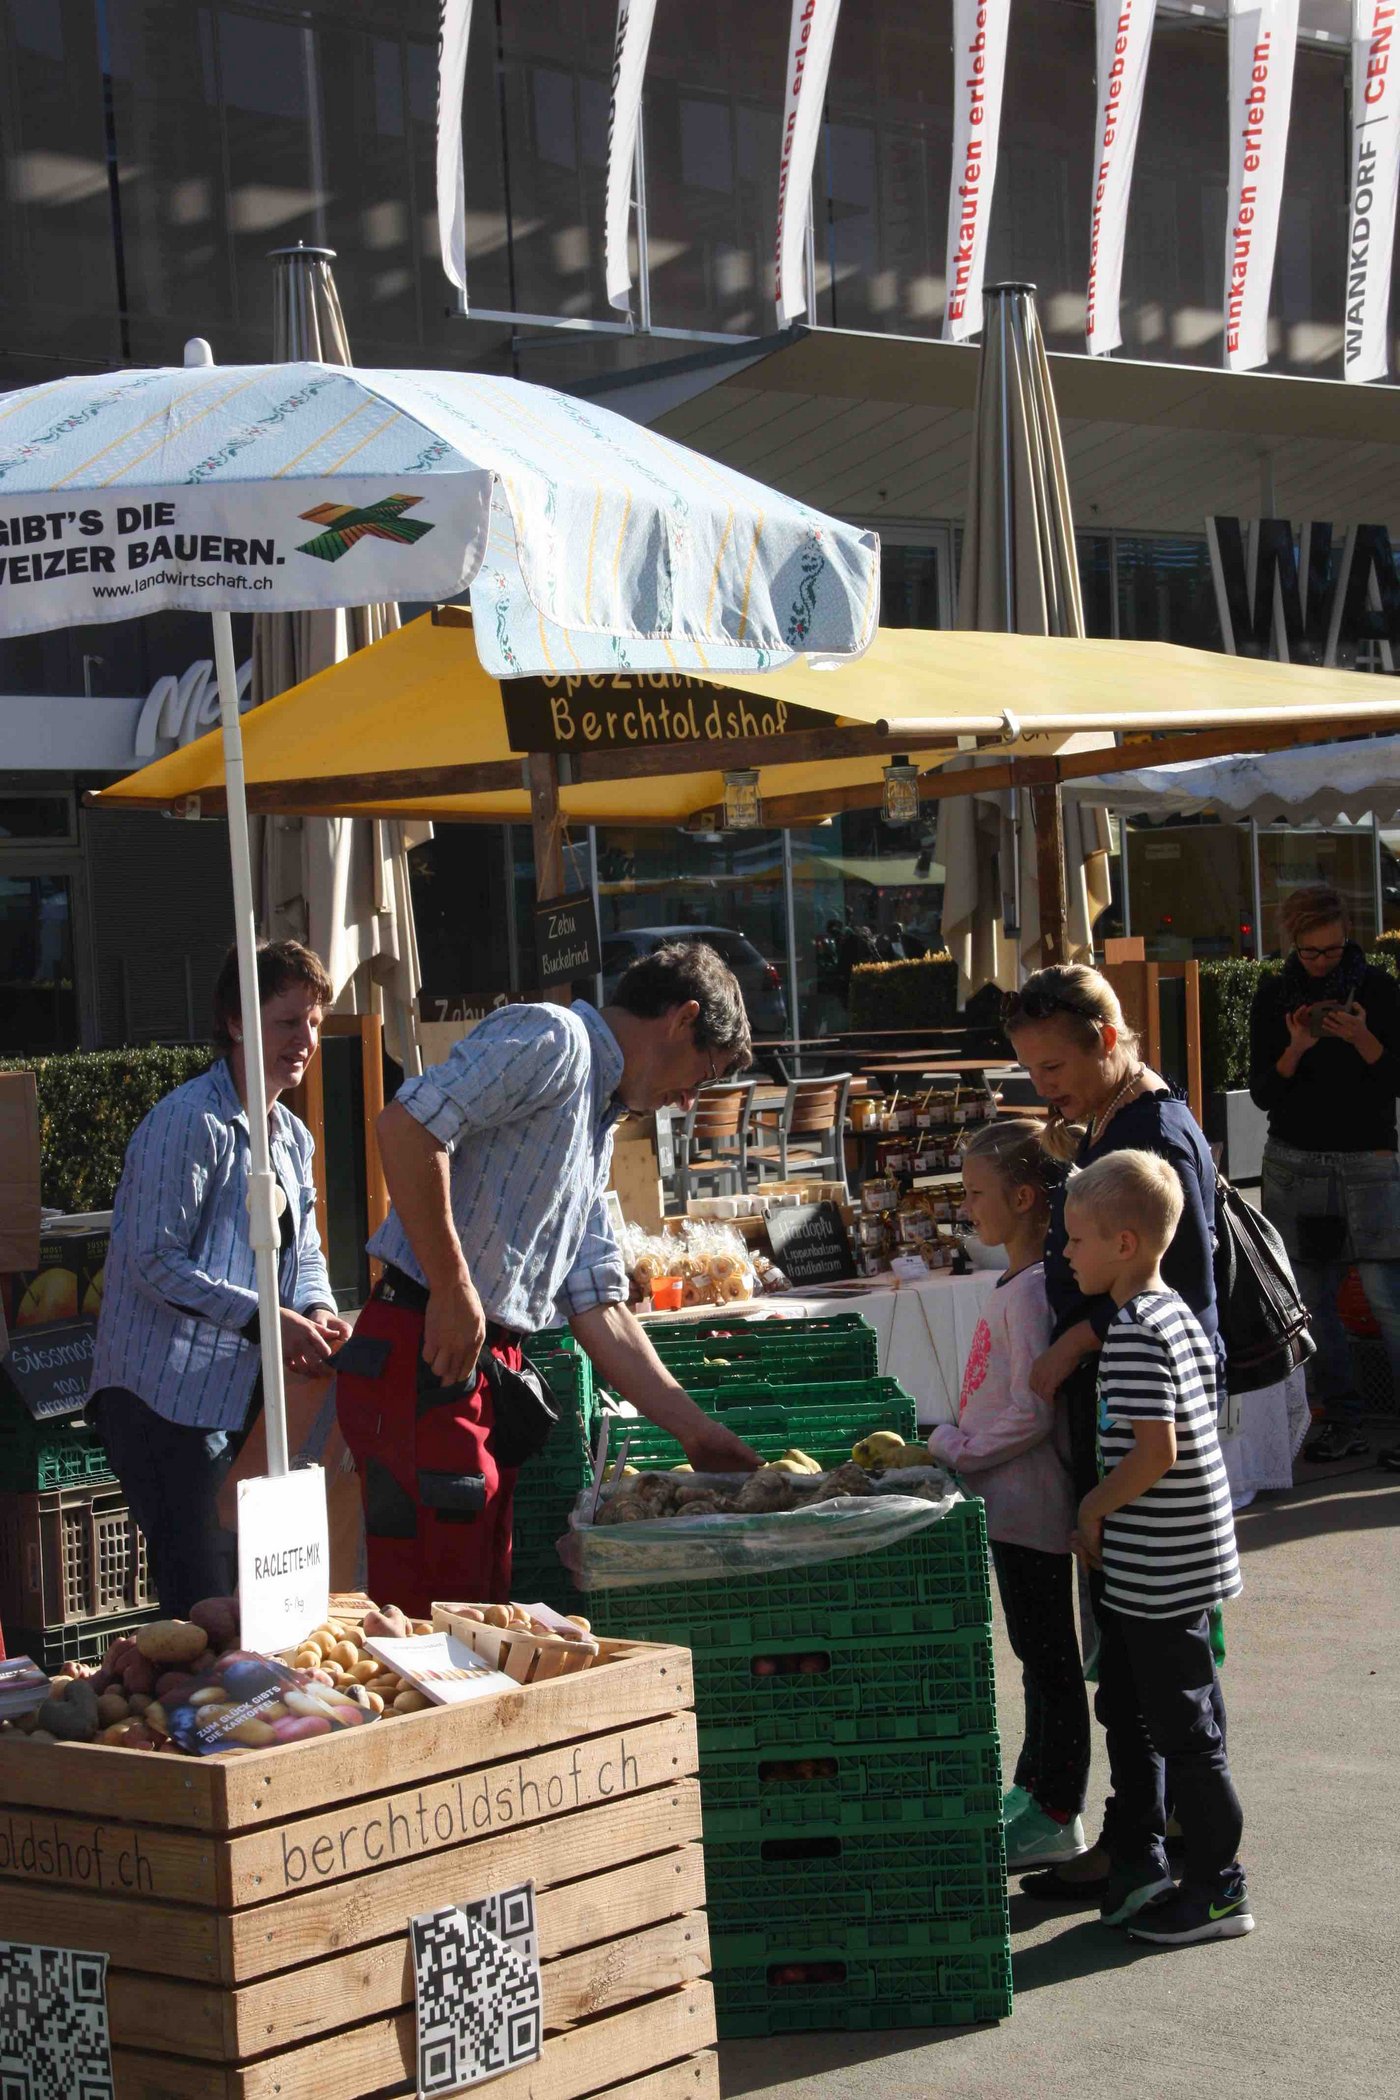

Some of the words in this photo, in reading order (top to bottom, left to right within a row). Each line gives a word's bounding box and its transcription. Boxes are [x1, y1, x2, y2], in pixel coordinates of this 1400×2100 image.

[948, 140, 983, 321] Einkaufen
[966, 0, 987, 126] erlebe
[1087, 160, 1110, 336] Einkaufen
[1103, 0, 1132, 148] erleben.
[1346, 140, 1377, 365] WANKDORF
[1364, 0, 1396, 105] CENT
[1226, 185, 1257, 353] Einkaufen
[1244, 31, 1271, 173] erleben.
[117, 502, 176, 534] DIE
[128, 534, 286, 570] BAUERN.
[93, 570, 273, 598] www.landwirtschaft.ch
[550, 697, 788, 741] Berchtoldshof
[548, 913, 576, 939] Zebu
[541, 940, 590, 976] Buckelrind
[12, 1333, 97, 1374] Süssmost
[255, 1541, 321, 1580] RACLETTE-MIX
[197, 1721, 220, 1738] ZUM
[219, 1701, 253, 1723] GLÜCK
[251, 1685, 281, 1704] GIBTS
[205, 1730, 224, 1744] DIE
[222, 1699, 280, 1732] KARTOFFEL.
[281, 1738, 639, 1886] berchtoldshof.ch
